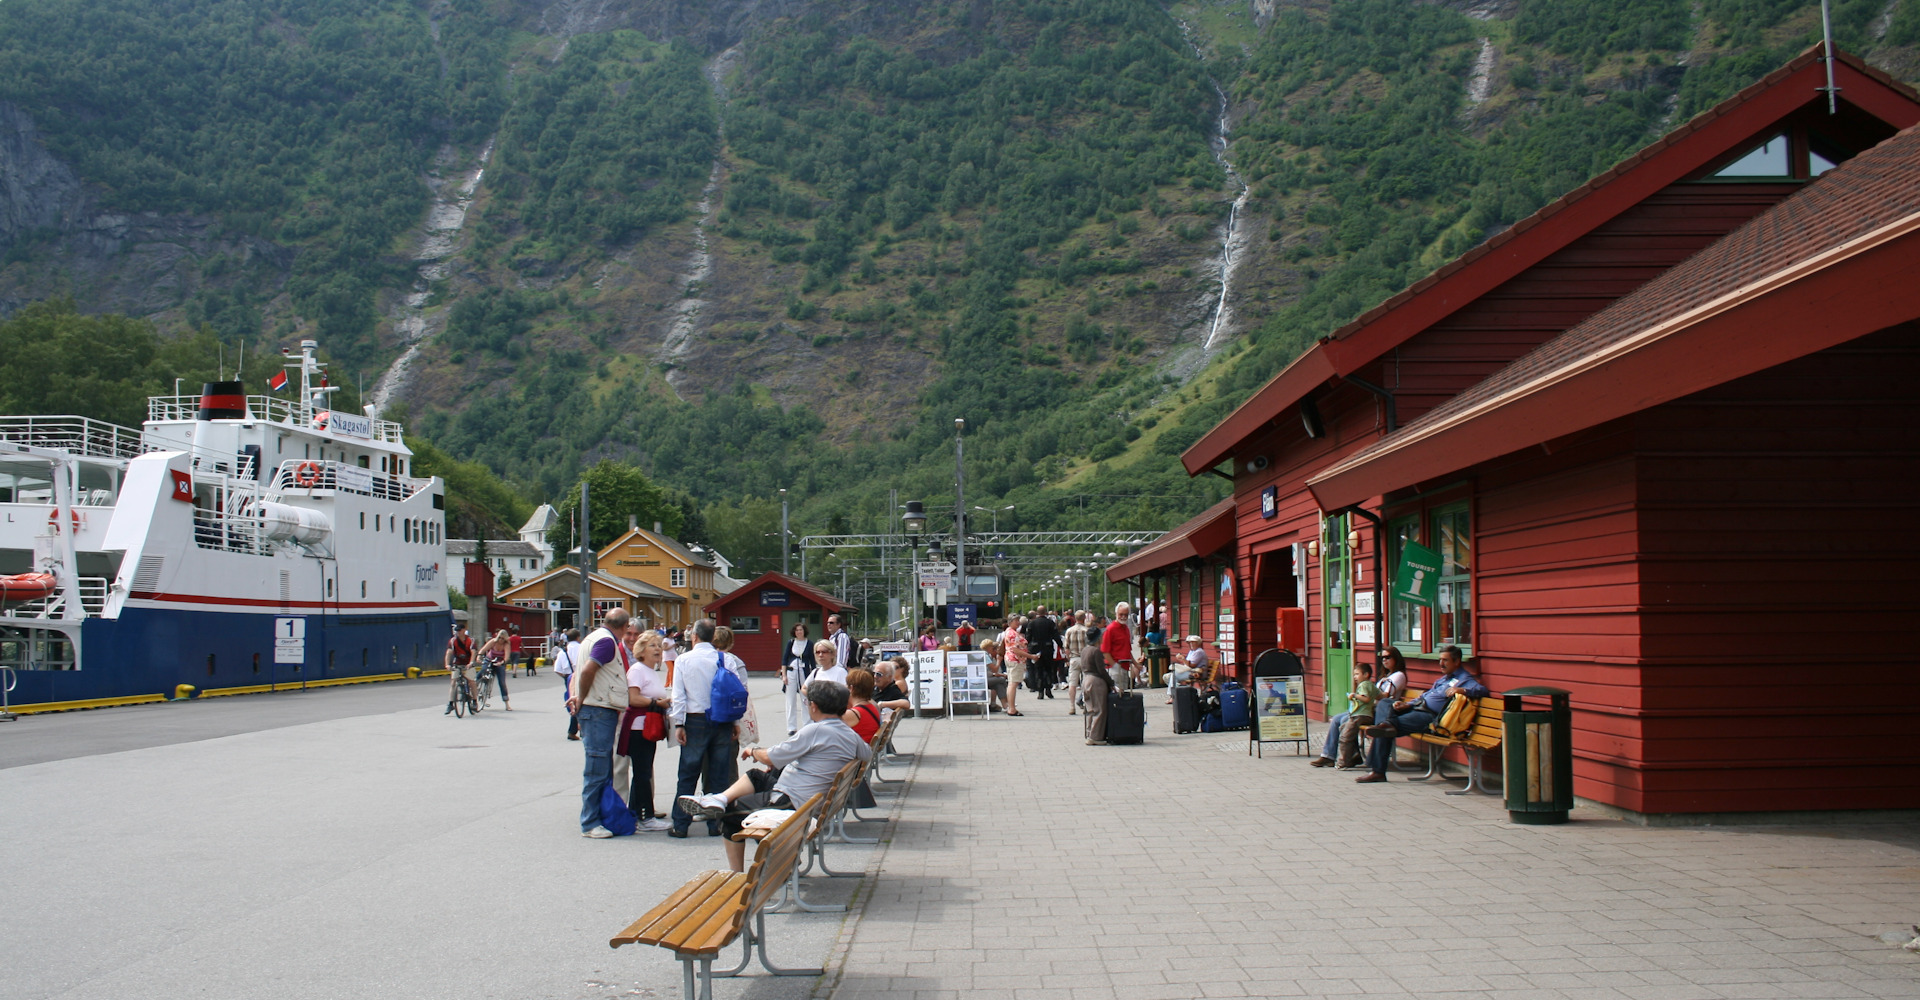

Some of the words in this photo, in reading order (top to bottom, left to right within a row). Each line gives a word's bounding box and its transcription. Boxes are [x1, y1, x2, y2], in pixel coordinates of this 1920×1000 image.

[332, 414, 370, 434] Skagastøl
[1262, 492, 1275, 513] Flåm
[1407, 560, 1436, 573] TOURIST
[285, 619, 294, 637] 1
[911, 656, 935, 665] LRGE
